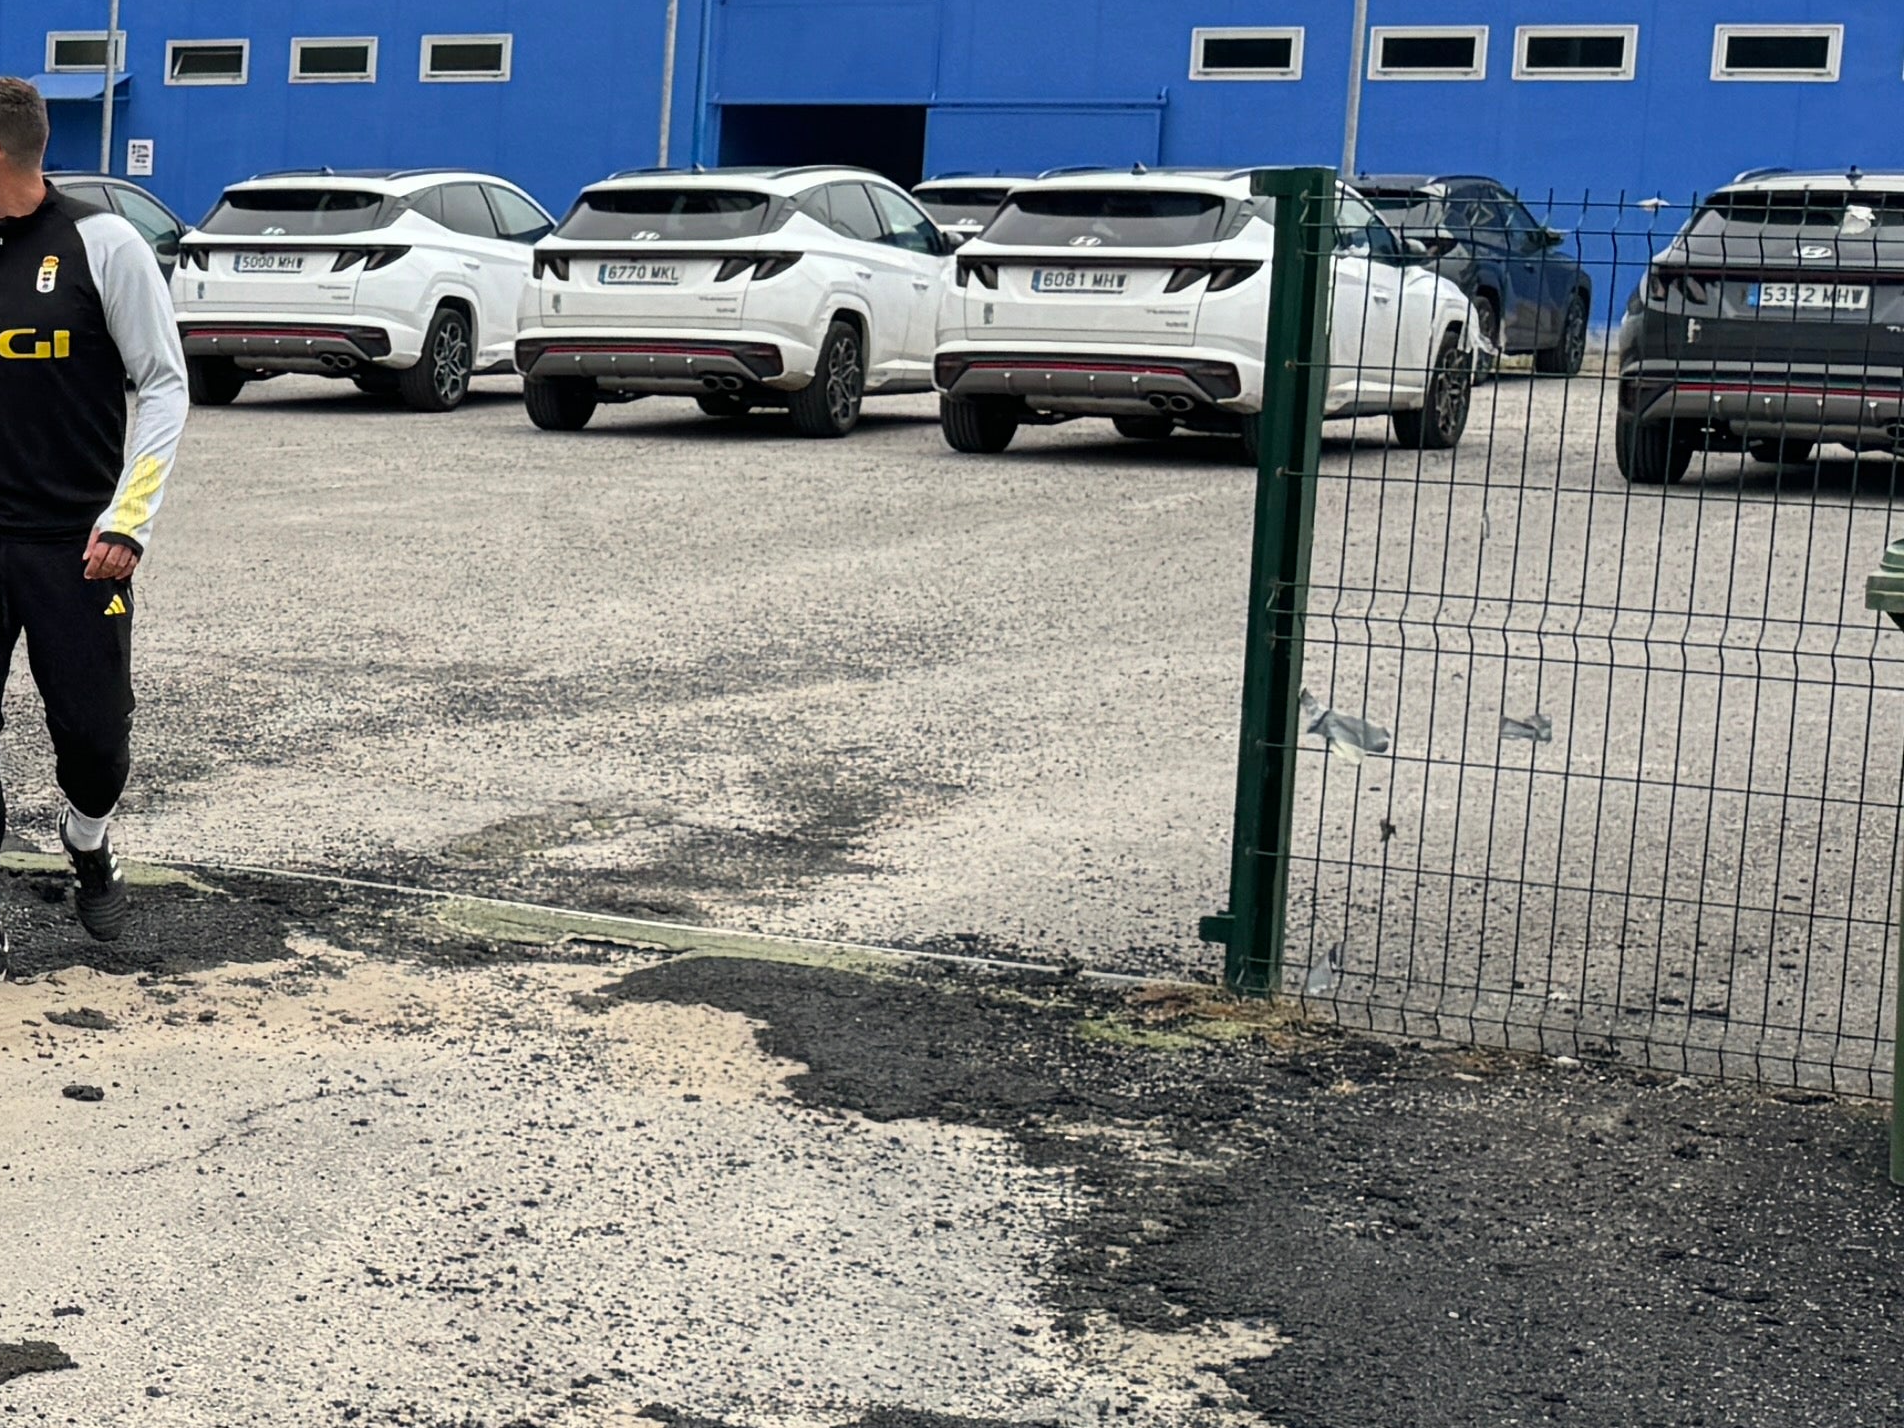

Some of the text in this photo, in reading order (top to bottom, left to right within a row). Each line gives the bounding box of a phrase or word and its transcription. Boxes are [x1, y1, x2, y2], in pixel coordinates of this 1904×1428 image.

[242, 256, 275, 269] 5000
[607, 265, 647, 279] 6770
[1043, 271, 1085, 287] 6081
[1822, 286, 1864, 304] MHW
